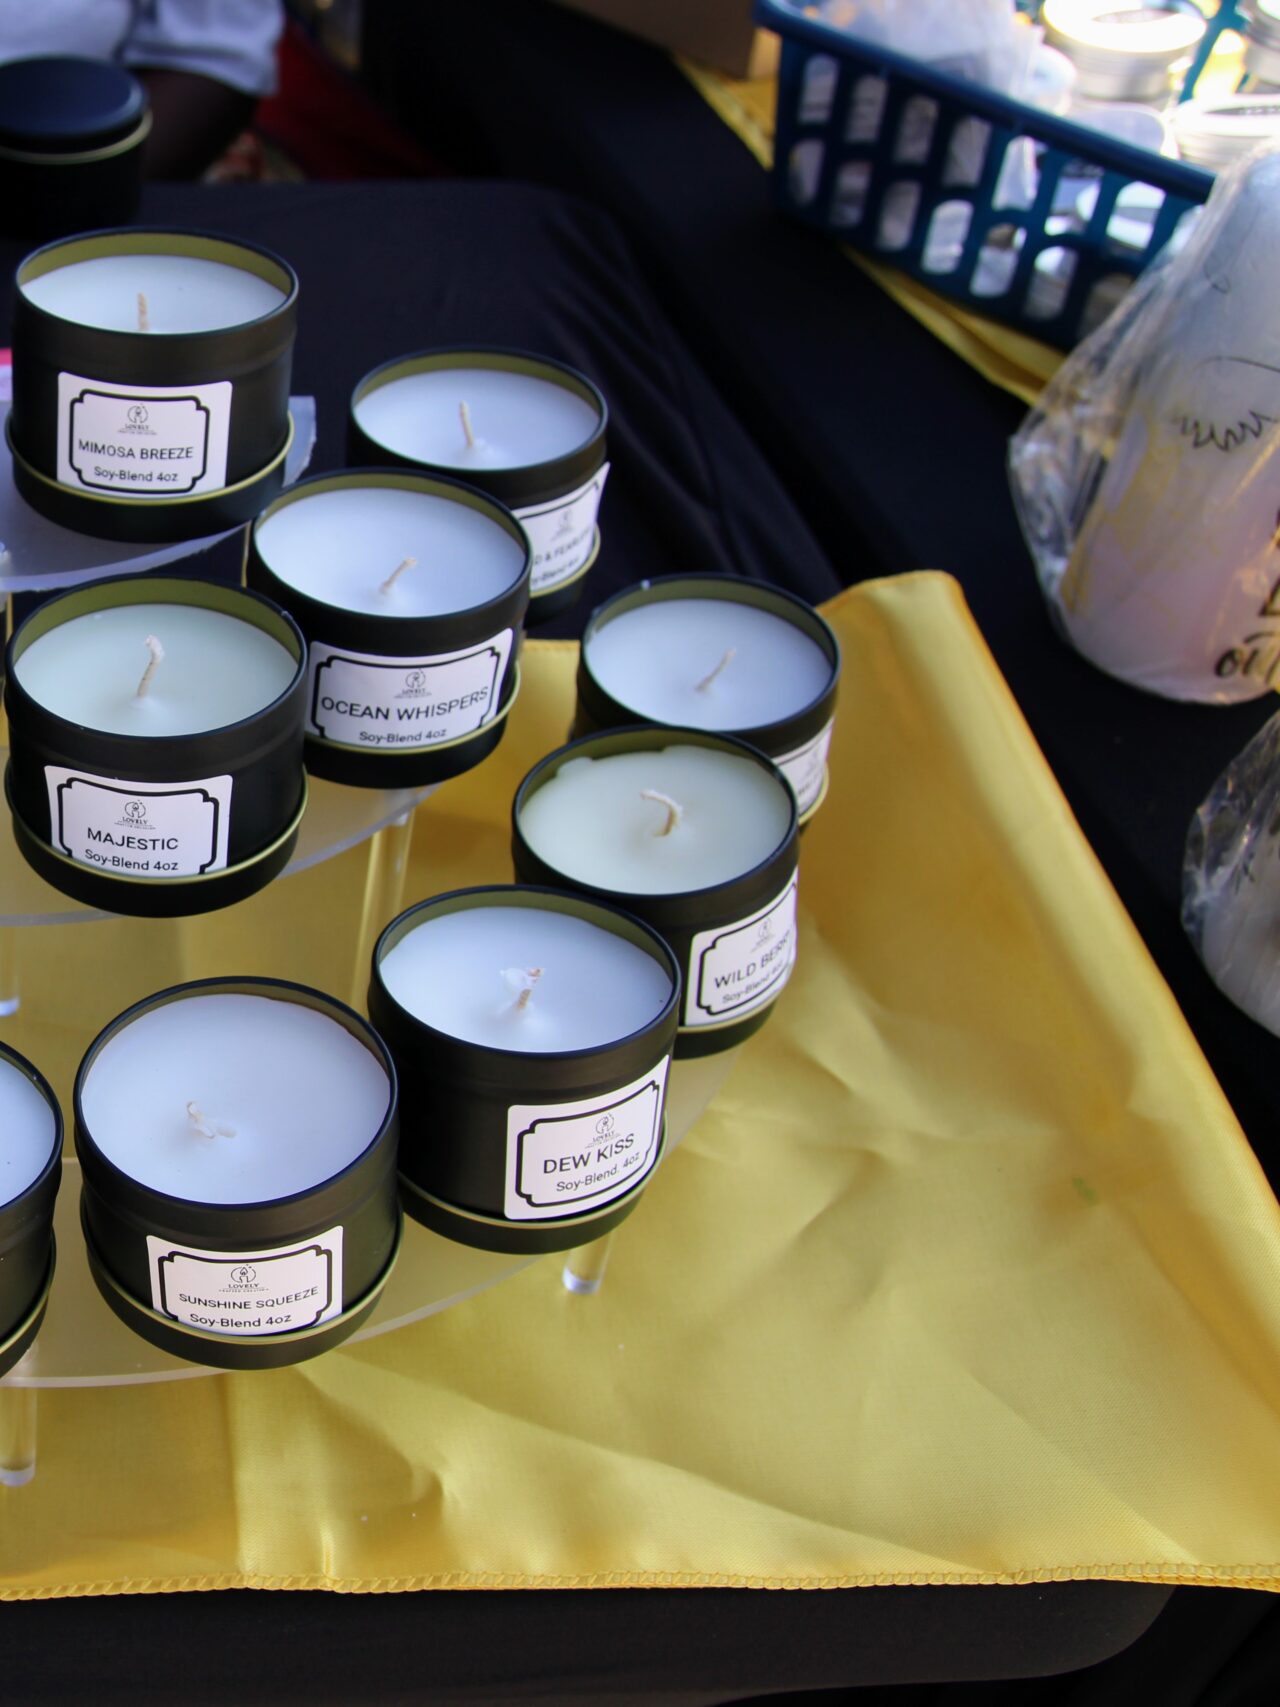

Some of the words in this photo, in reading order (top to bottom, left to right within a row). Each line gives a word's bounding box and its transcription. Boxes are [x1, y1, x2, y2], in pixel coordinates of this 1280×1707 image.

[78, 438, 136, 460] MIMOSA
[140, 447, 194, 460] BREEZE
[93, 466, 153, 482] Soy-Blend
[156, 472, 179, 482] 4oz
[321, 696, 390, 720] OCEAN
[397, 686, 489, 720] WHISPERS
[359, 731, 422, 744] Soy-Blend
[425, 729, 447, 740] 4oz
[87, 827, 179, 850] MAJESTIC
[84, 848, 150, 871] Soy-Blend
[153, 860, 179, 871] 4oz
[715, 962, 757, 988] WILD
[543, 1152, 591, 1174] DEW
[596, 1133, 635, 1163] KISS
[623, 1152, 640, 1168] 4oz
[178, 1293, 252, 1310] SUNSHINE
[255, 1286, 319, 1309] SQUEEZE
[189, 1313, 261, 1328] Soy-Blend
[265, 1314, 292, 1326] 4oz
